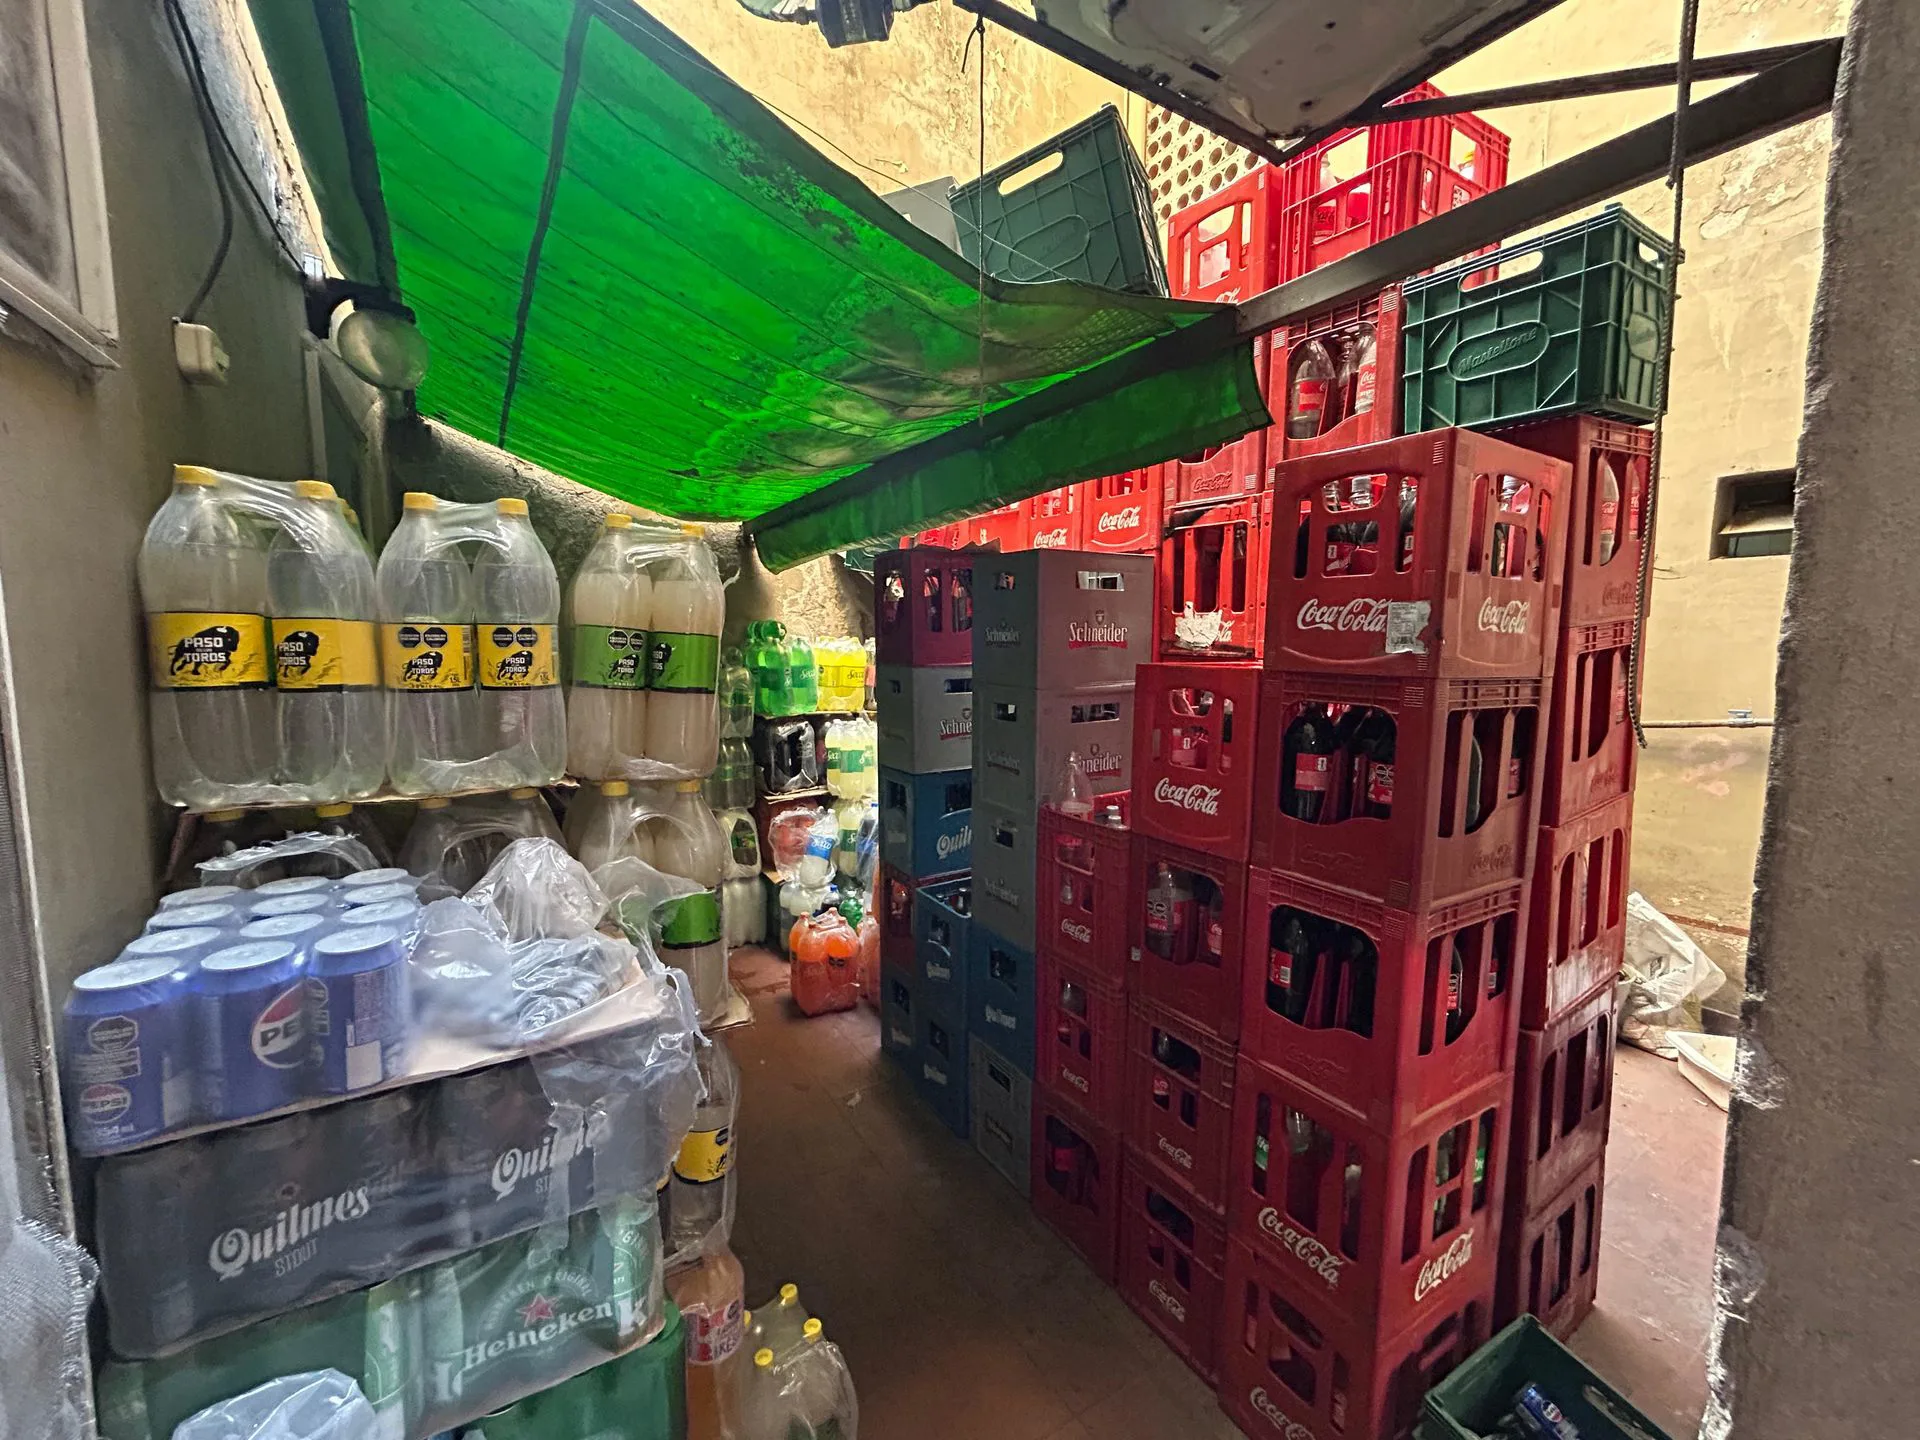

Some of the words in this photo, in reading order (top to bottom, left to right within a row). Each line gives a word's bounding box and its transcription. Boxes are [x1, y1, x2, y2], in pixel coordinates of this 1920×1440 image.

[1098, 505, 1141, 532] Coca-Cola
[1033, 528, 1069, 549] Coca-Cola
[1069, 621, 1128, 642] Schneider
[1296, 598, 1392, 632] Coca-Cola
[1478, 597, 1529, 634] Coca-Cola
[184, 637, 224, 649] PASO
[184, 652, 227, 663] TOROS
[279, 641, 305, 652] PASO
[411, 658, 434, 666] PASO
[505, 657, 526, 665] PASO
[1154, 777, 1221, 815] Coca-Cola
[936, 825, 972, 860] Quil
[208, 1186, 370, 1282] Quilmes
[1258, 1206, 1344, 1285] Coca-Cola
[274, 1237, 318, 1278] STOUT
[1414, 1227, 1473, 1301] Coca-Cola
[461, 1300, 614, 1372] Heineken
